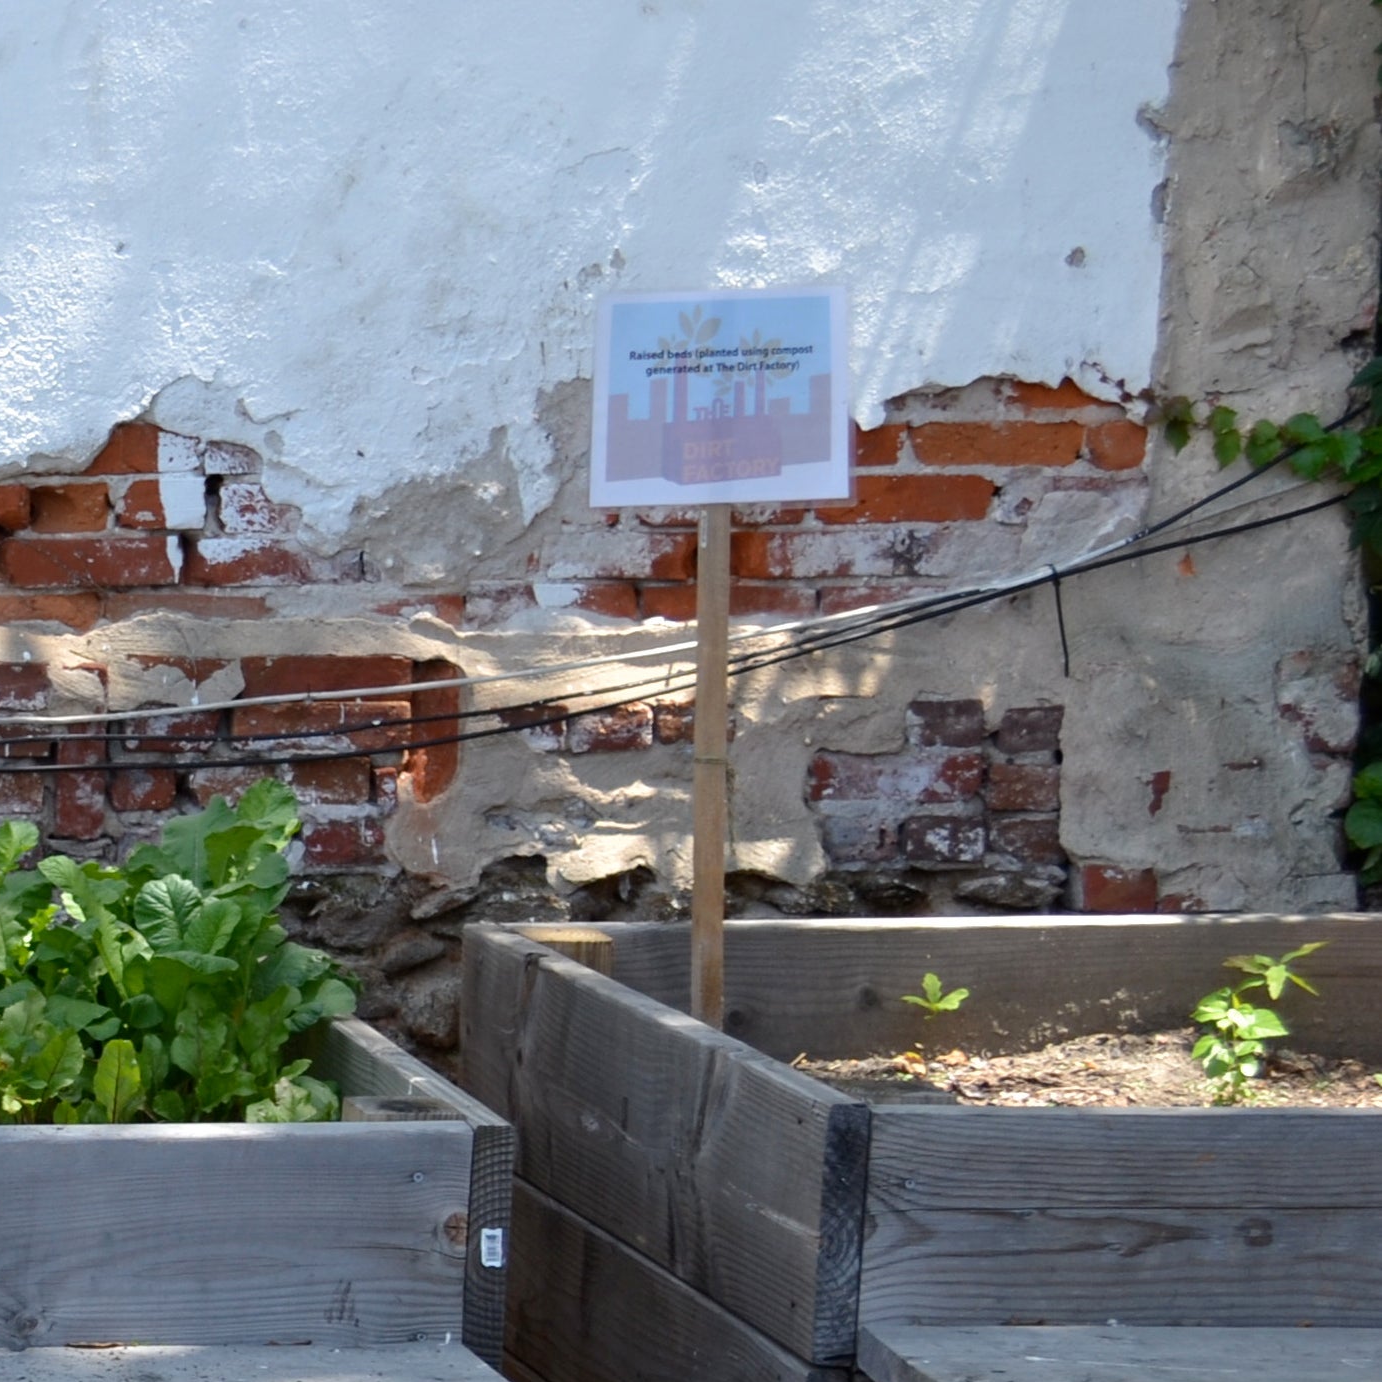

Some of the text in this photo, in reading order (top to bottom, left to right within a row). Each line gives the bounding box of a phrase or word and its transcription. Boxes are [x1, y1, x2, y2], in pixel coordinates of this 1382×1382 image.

[629, 345, 813, 361] Raised beds (planted using compost
[646, 364, 700, 376] generated
[703, 364, 713, 373] at
[717, 362, 735, 372] The
[738, 362, 757, 372] Dirt
[684, 441, 734, 458] DIRT
[684, 459, 779, 481] FACTORY
